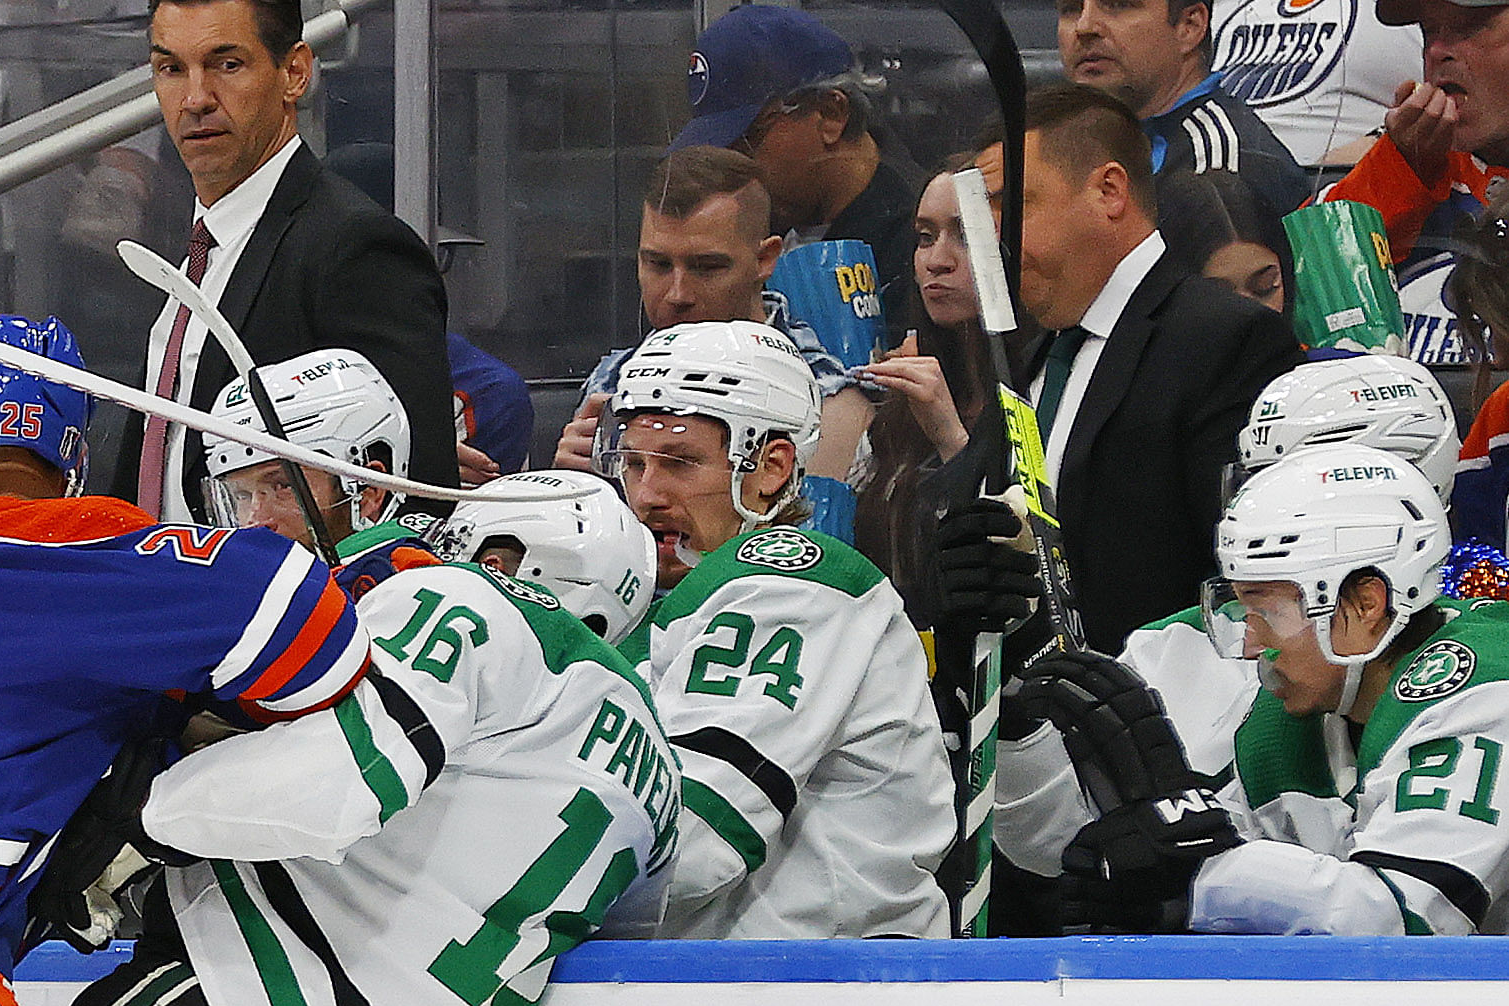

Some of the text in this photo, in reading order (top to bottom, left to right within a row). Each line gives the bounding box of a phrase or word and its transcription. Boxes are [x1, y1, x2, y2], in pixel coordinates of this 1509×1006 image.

[1226, 23, 1337, 67] OILERS
[626, 367, 672, 379] CCM
[1350, 385, 1418, 402] 7-ELEVEN
[1318, 466, 1399, 484] 7-ELEVEN
[614, 568, 641, 605] 16
[373, 588, 489, 684] 16
[685, 611, 805, 711] 24
[1394, 735, 1504, 827] 21
